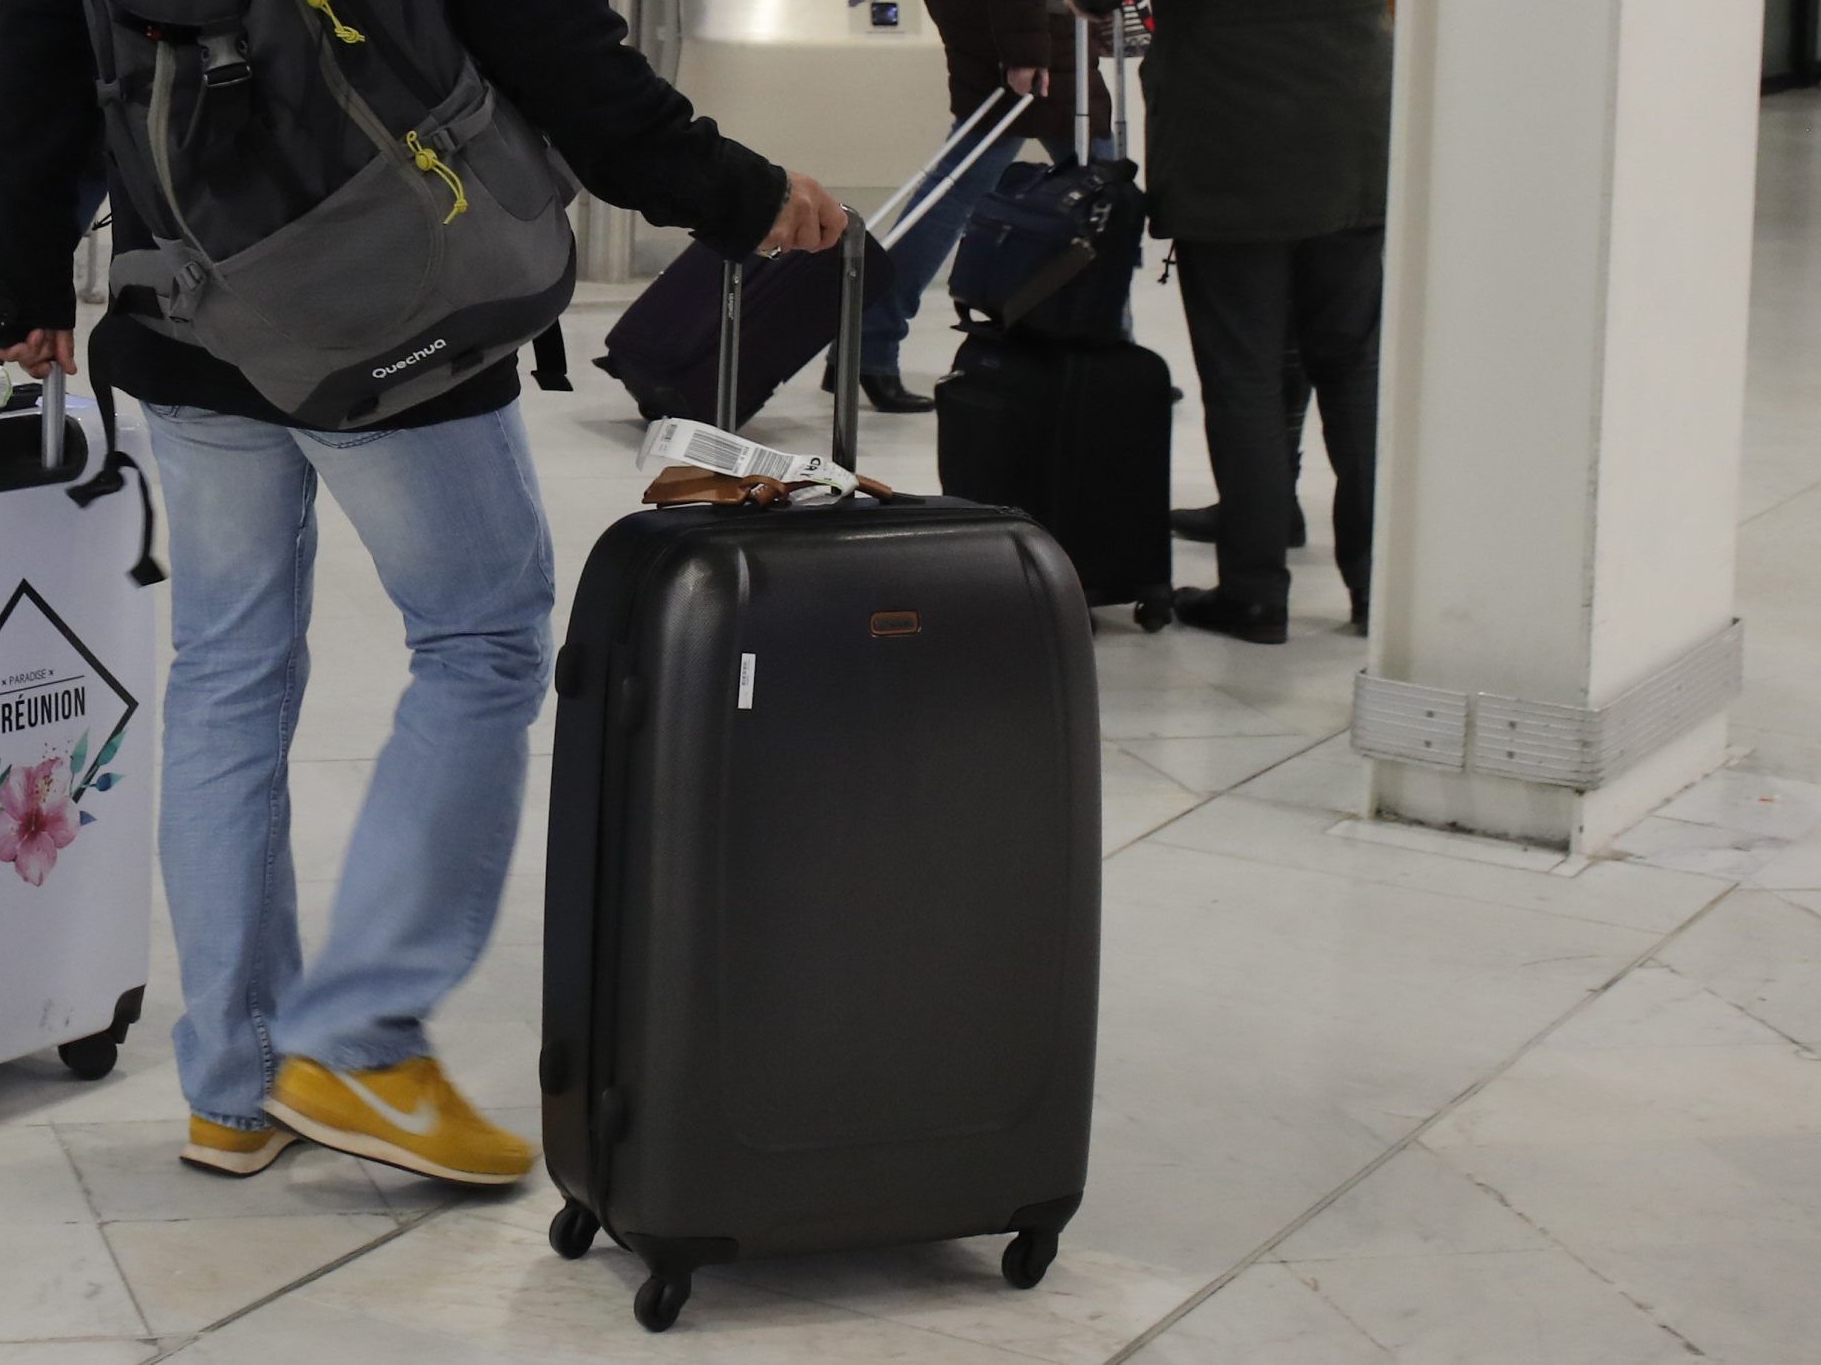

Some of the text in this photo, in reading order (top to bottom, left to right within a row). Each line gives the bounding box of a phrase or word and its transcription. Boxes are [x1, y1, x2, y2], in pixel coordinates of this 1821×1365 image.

[372, 338, 446, 378] Quechua
[9, 669, 47, 685] PARADISE
[2, 686, 85, 734] RÉUNION
